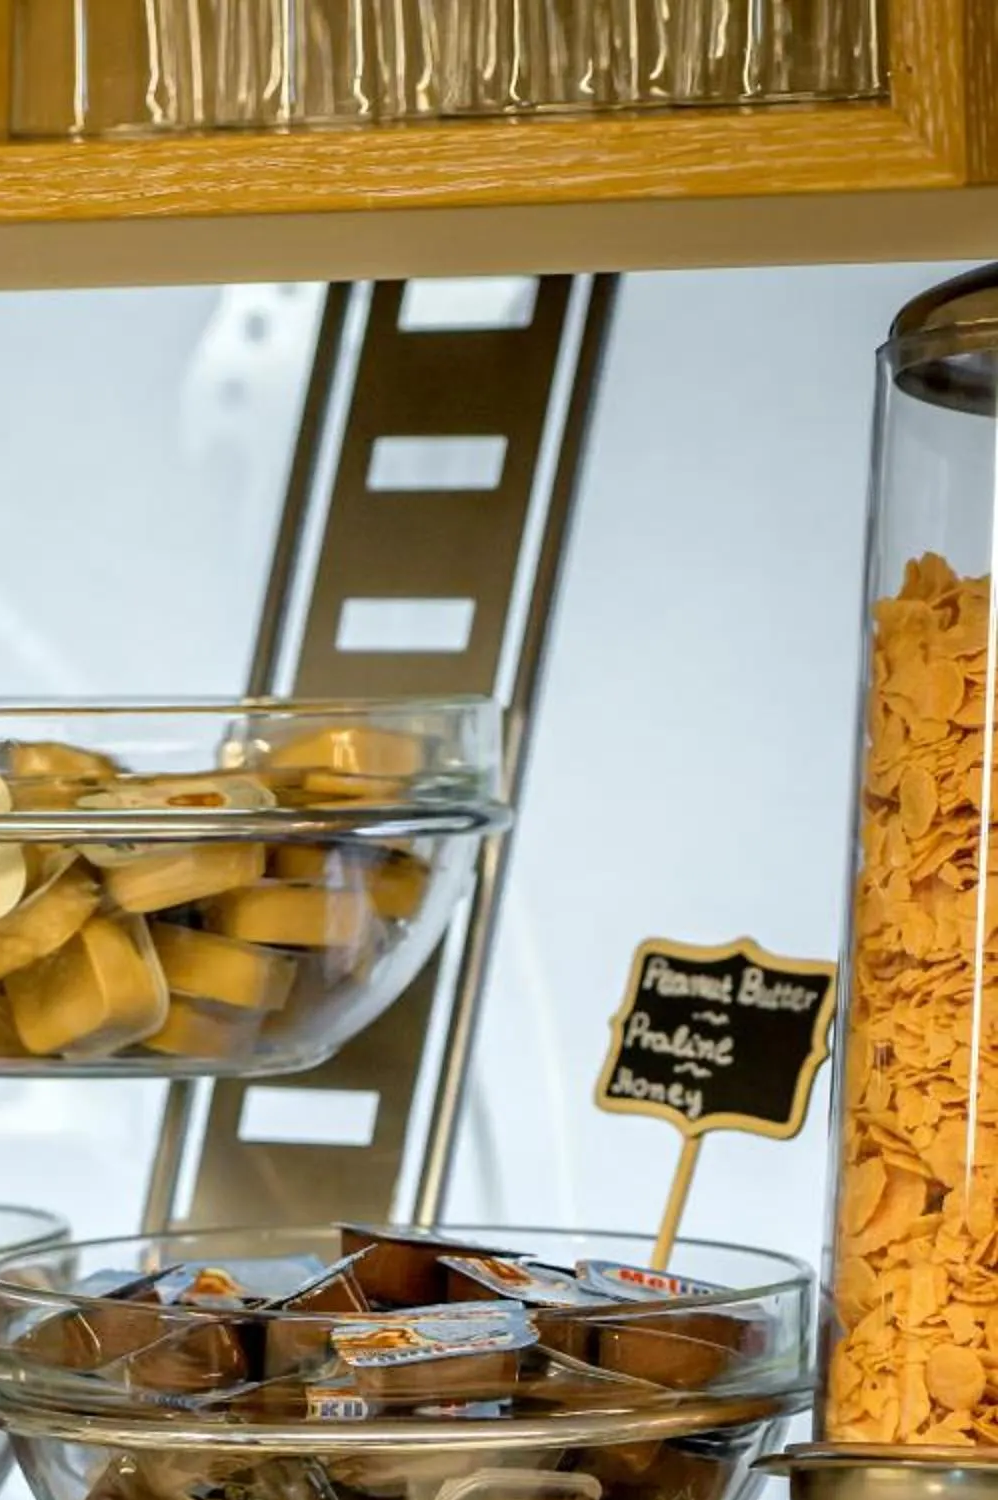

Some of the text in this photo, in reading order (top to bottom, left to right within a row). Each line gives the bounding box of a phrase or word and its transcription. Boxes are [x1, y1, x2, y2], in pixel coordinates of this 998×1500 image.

[642, 957, 818, 1011] Peanut Butter
[624, 1011, 734, 1066] Praline
[610, 1066, 702, 1118] Honey
